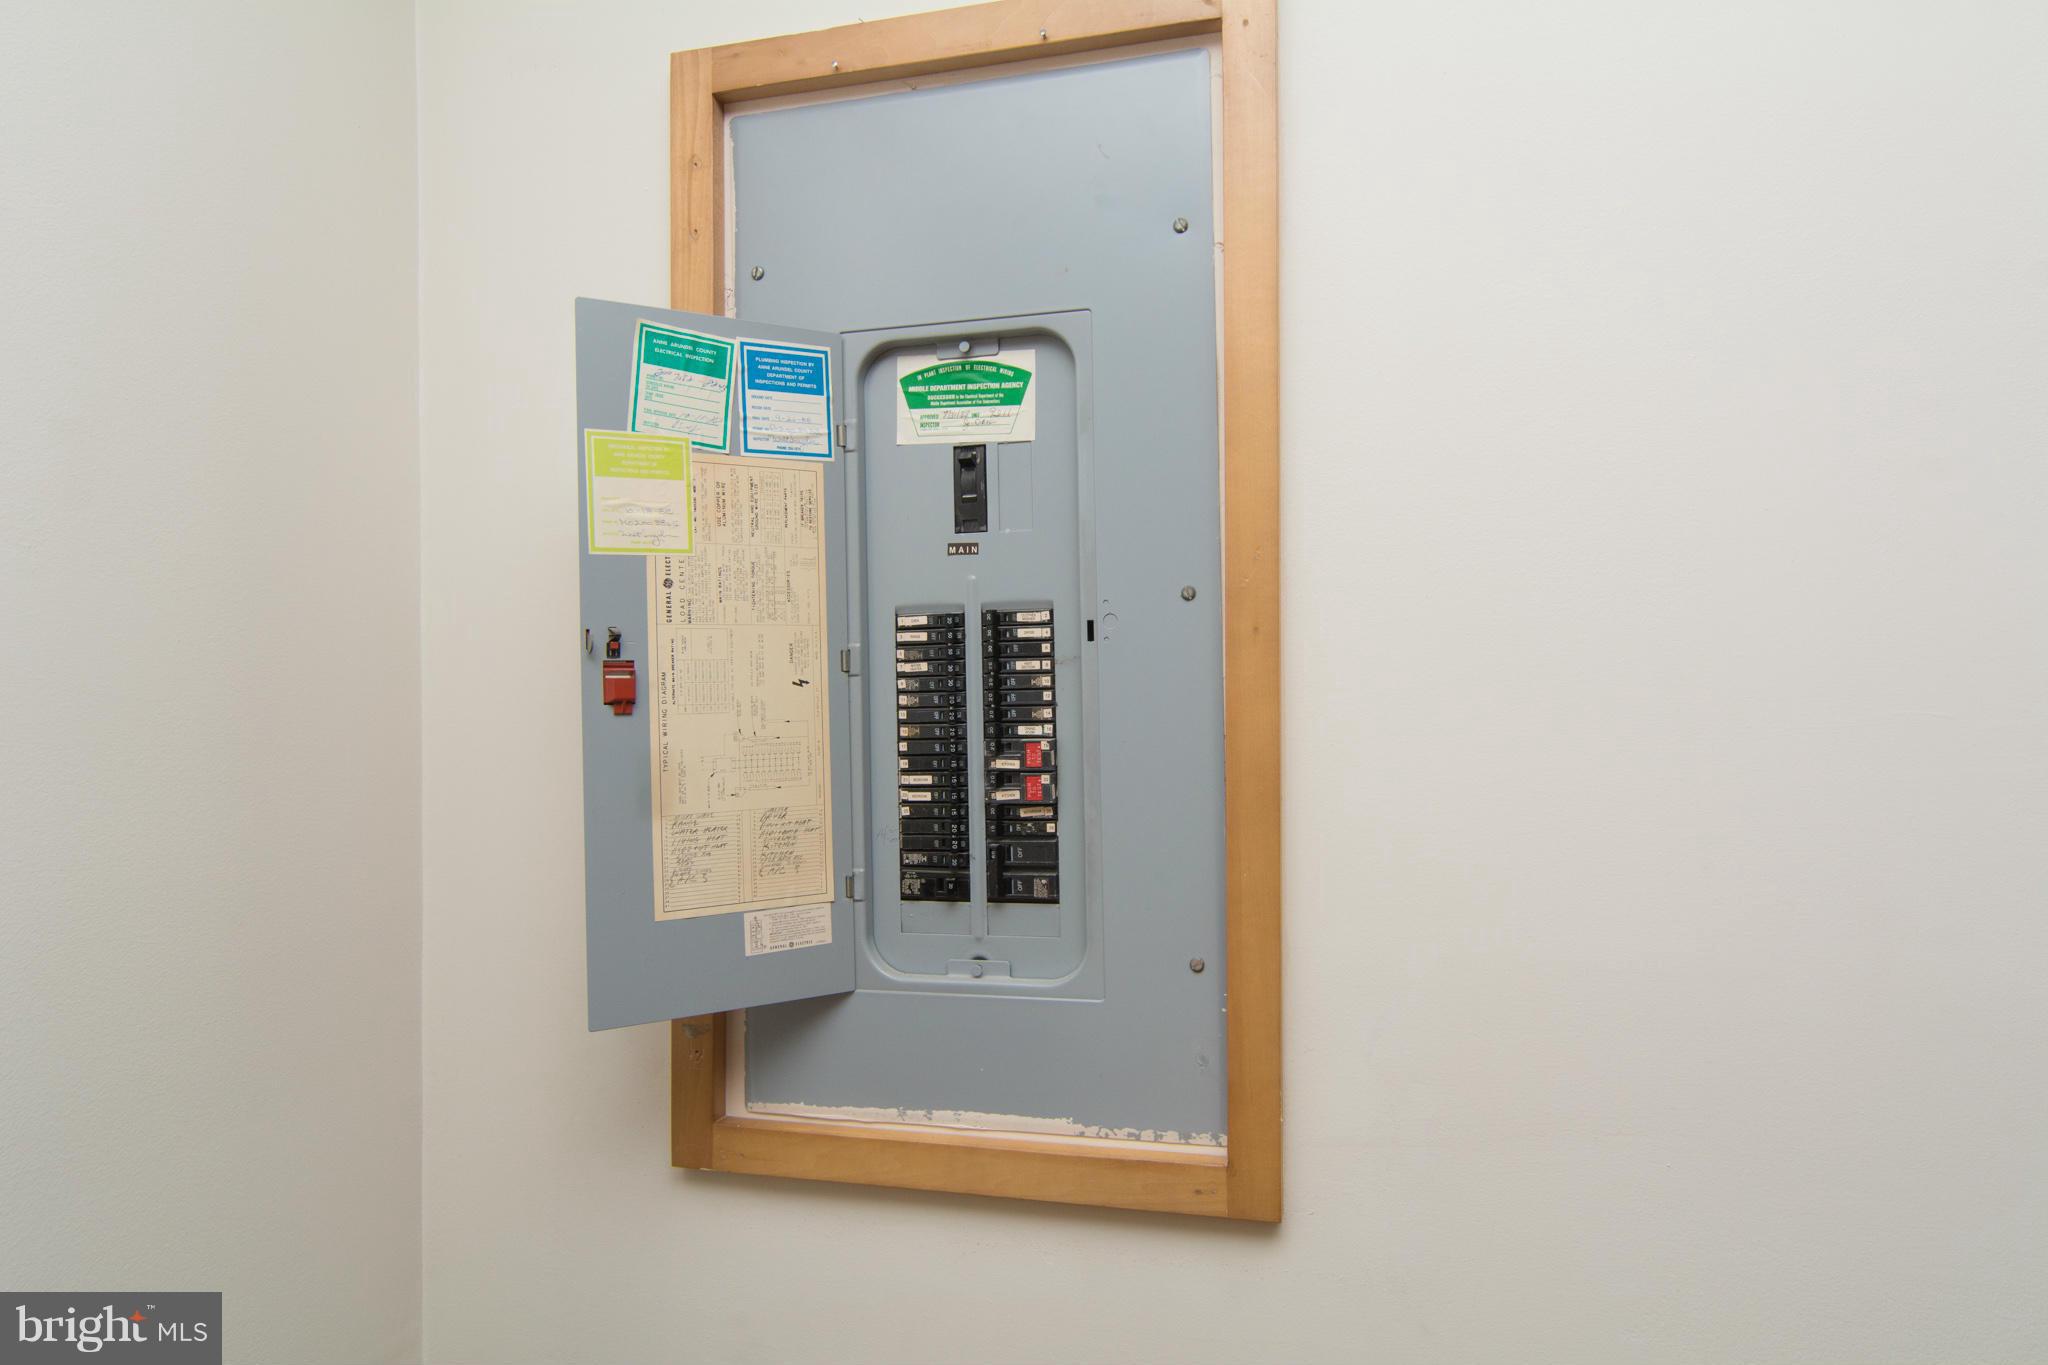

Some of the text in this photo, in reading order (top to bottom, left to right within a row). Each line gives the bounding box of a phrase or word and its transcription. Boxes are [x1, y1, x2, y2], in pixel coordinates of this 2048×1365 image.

[655, 348, 682, 357] ELECTRICAL
[938, 365, 961, 374] INSPECTION
[949, 712, 955, 720] 20
[950, 728, 955, 736] 20
[952, 824, 957, 832] 20
[952, 840, 958, 849] 20
